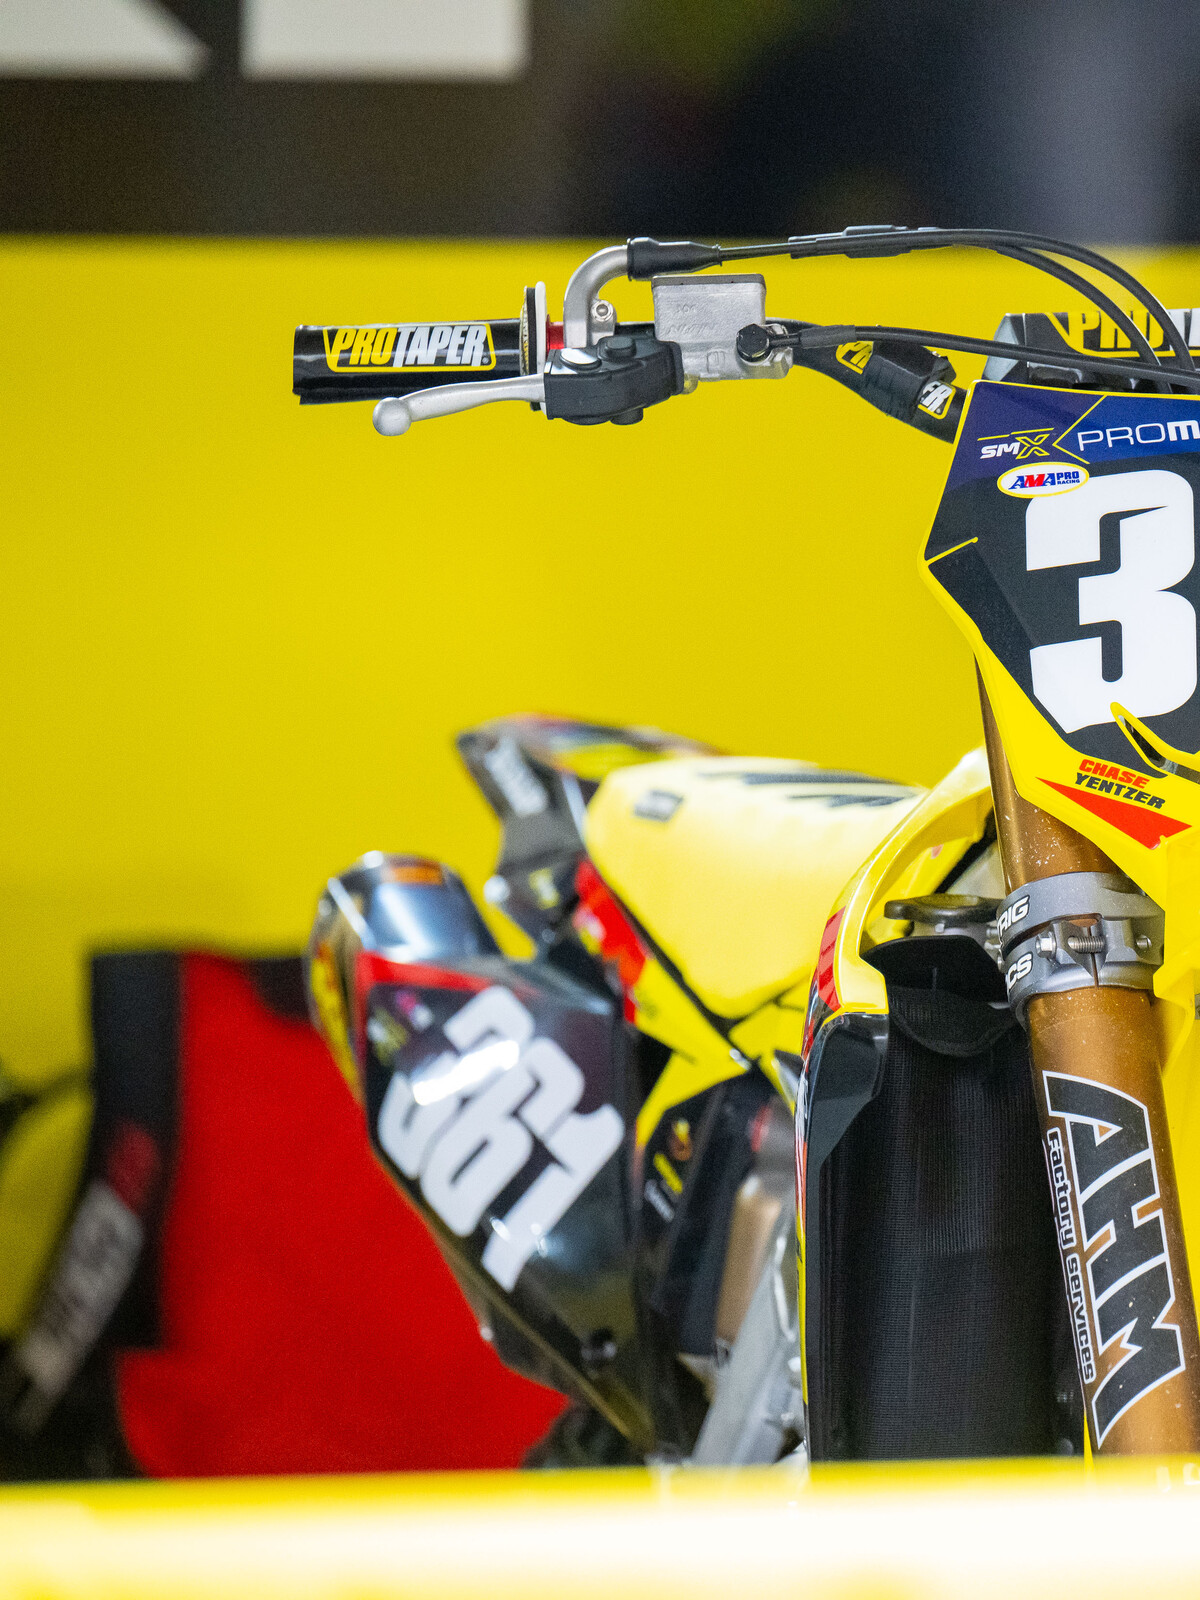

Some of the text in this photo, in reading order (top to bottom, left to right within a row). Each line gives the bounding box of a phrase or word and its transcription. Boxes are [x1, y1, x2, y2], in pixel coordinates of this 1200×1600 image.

[332, 325, 488, 368] PROTAPER
[980, 434, 1050, 459] SMX
[1008, 471, 1080, 490] AMA PRO
[1075, 772, 1166, 809] YENTZER
[1079, 758, 1150, 789] CHASE
[378, 984, 626, 1294] 361
[1042, 1069, 1187, 1450] AHM
